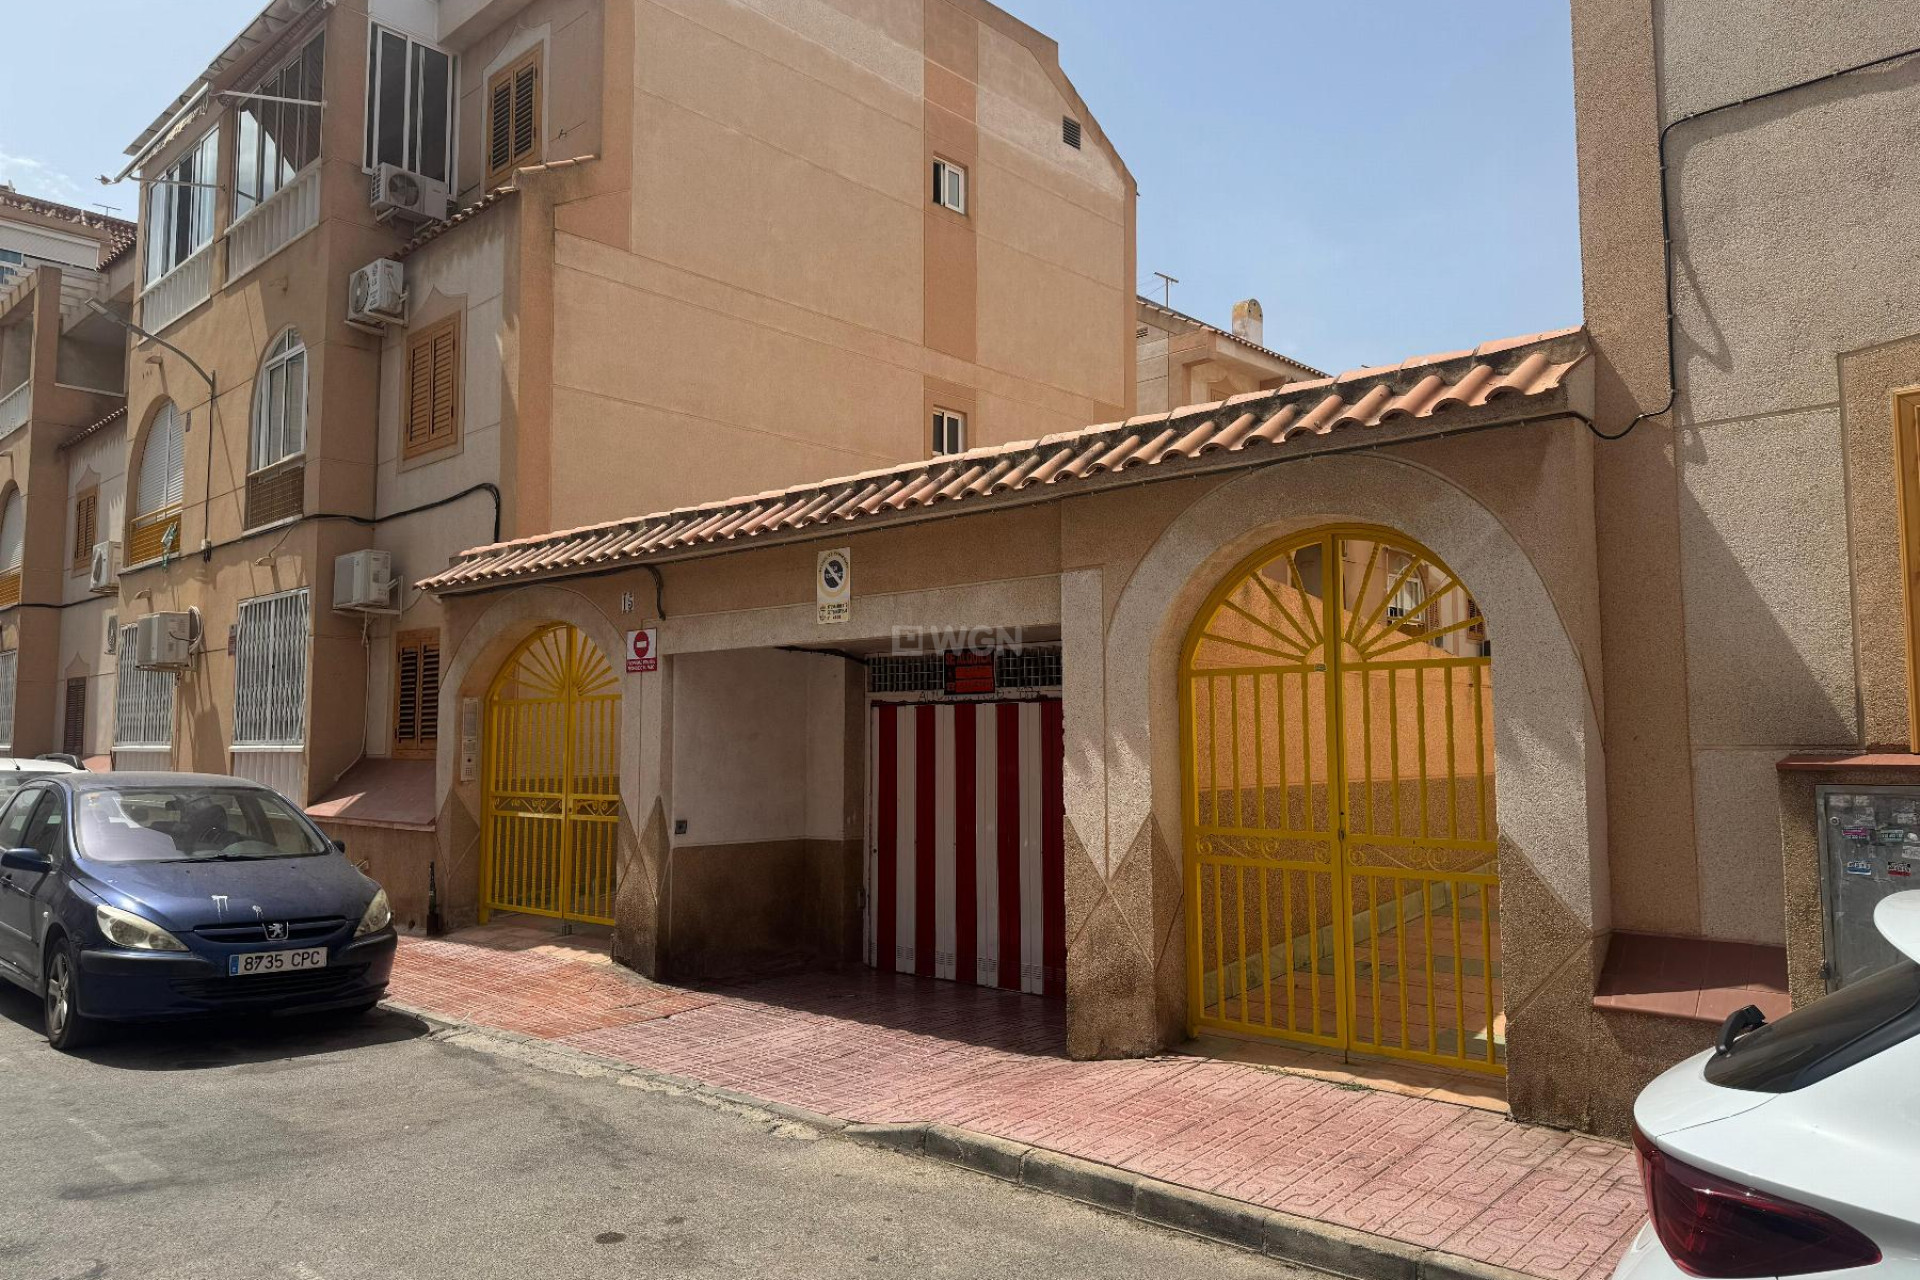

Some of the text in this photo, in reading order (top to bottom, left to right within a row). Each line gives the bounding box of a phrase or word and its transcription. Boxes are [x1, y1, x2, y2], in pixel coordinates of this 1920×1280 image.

[623, 592, 633, 610] 15
[244, 951, 320, 971] 8735 CPC
